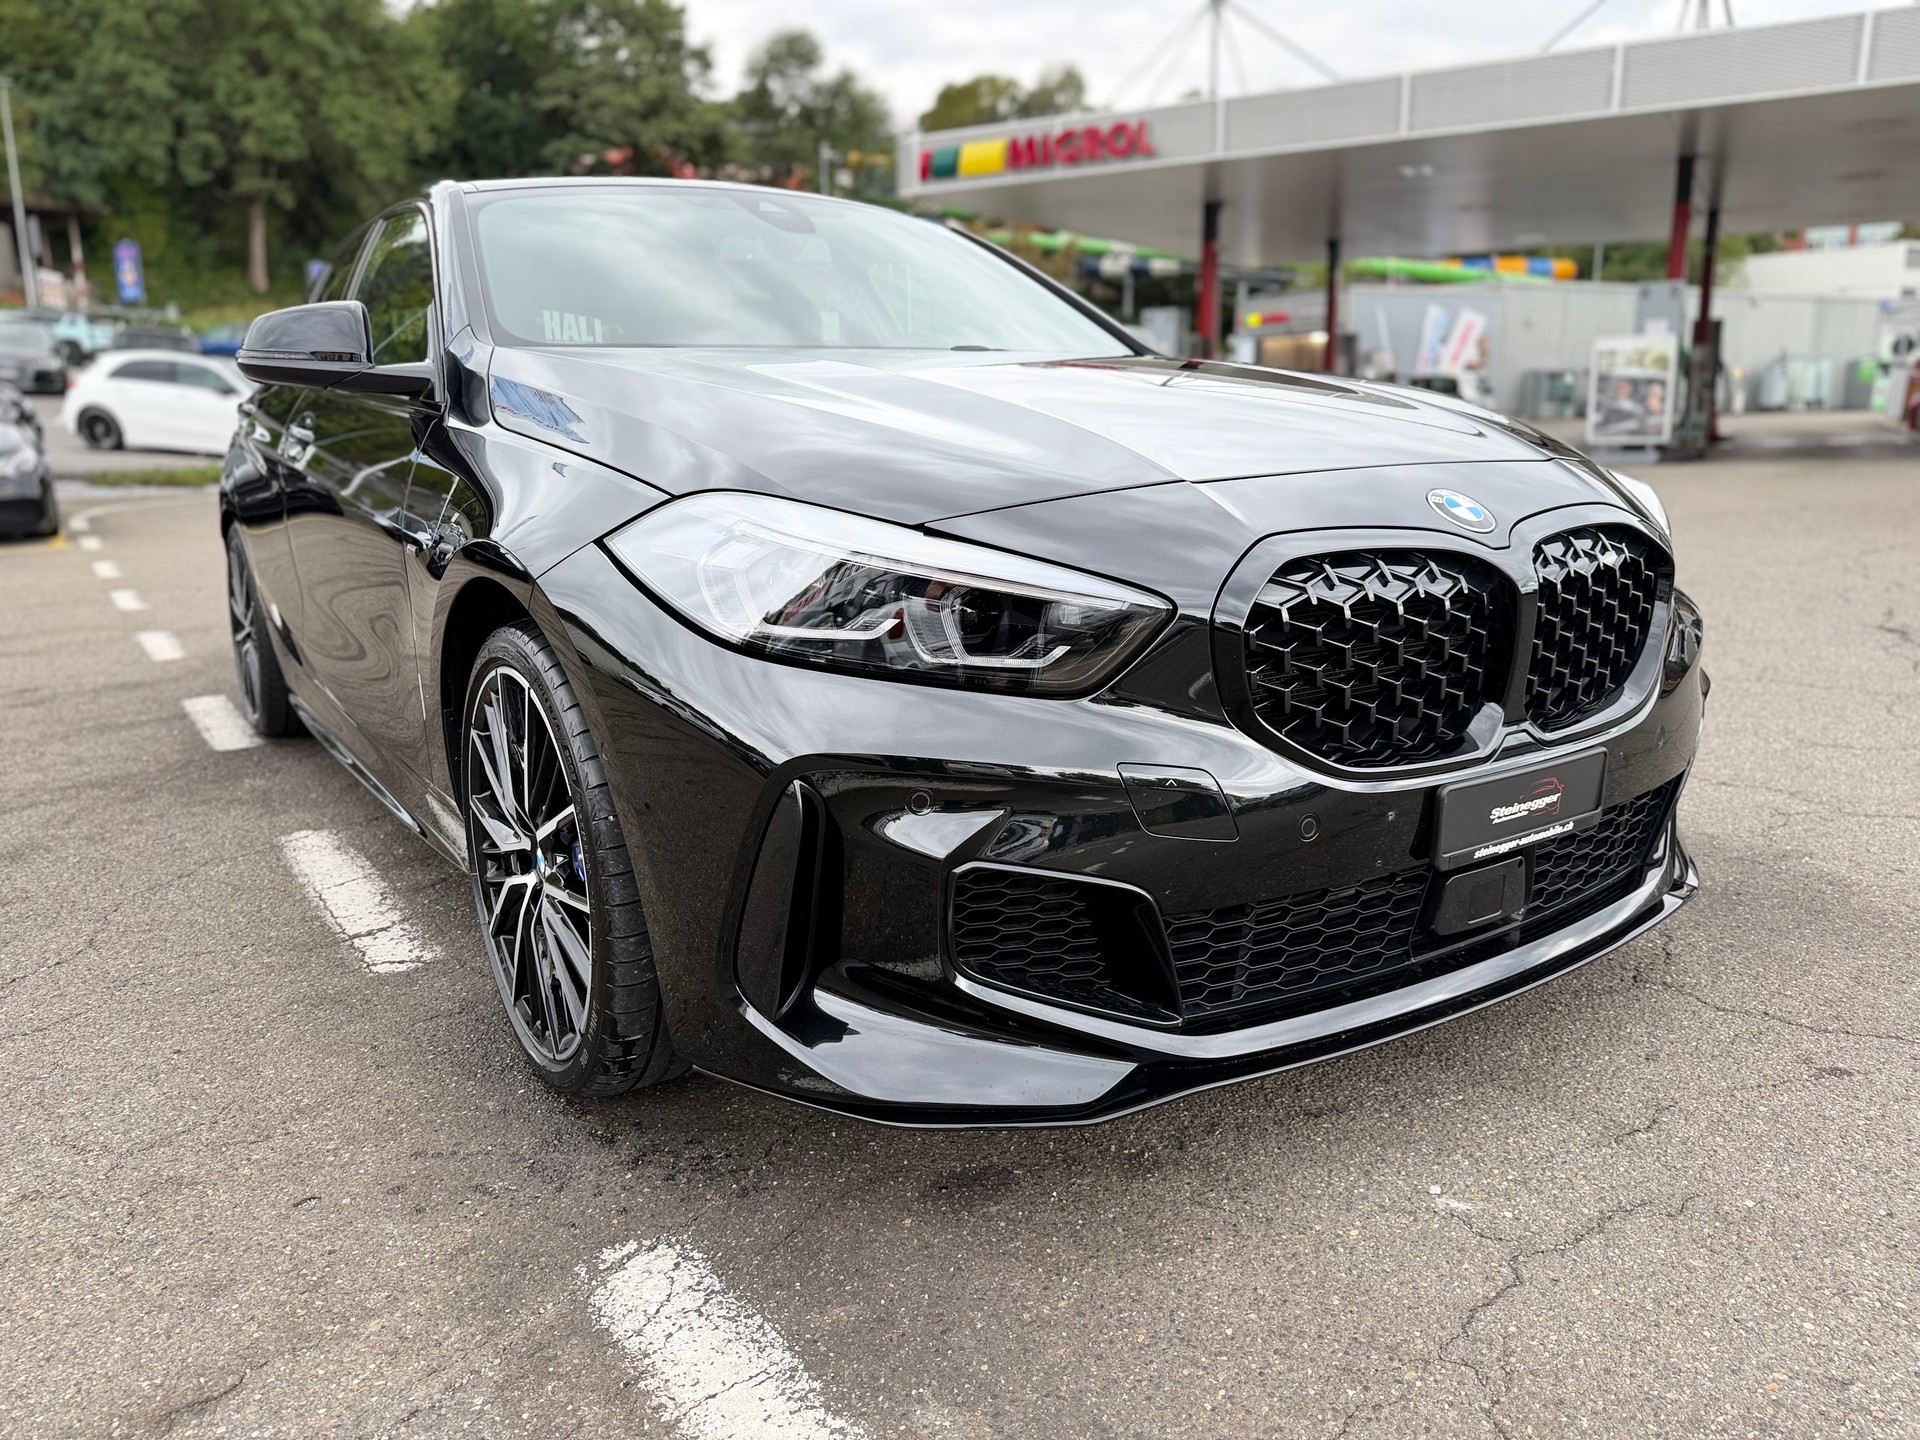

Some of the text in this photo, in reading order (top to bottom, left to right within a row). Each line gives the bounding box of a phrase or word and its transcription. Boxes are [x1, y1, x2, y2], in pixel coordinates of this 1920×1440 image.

[1006, 120, 1154, 170] MIGROL
[1490, 793, 1562, 819] Steinegger
[1473, 821, 1575, 859] steinegger-automobile.ch
